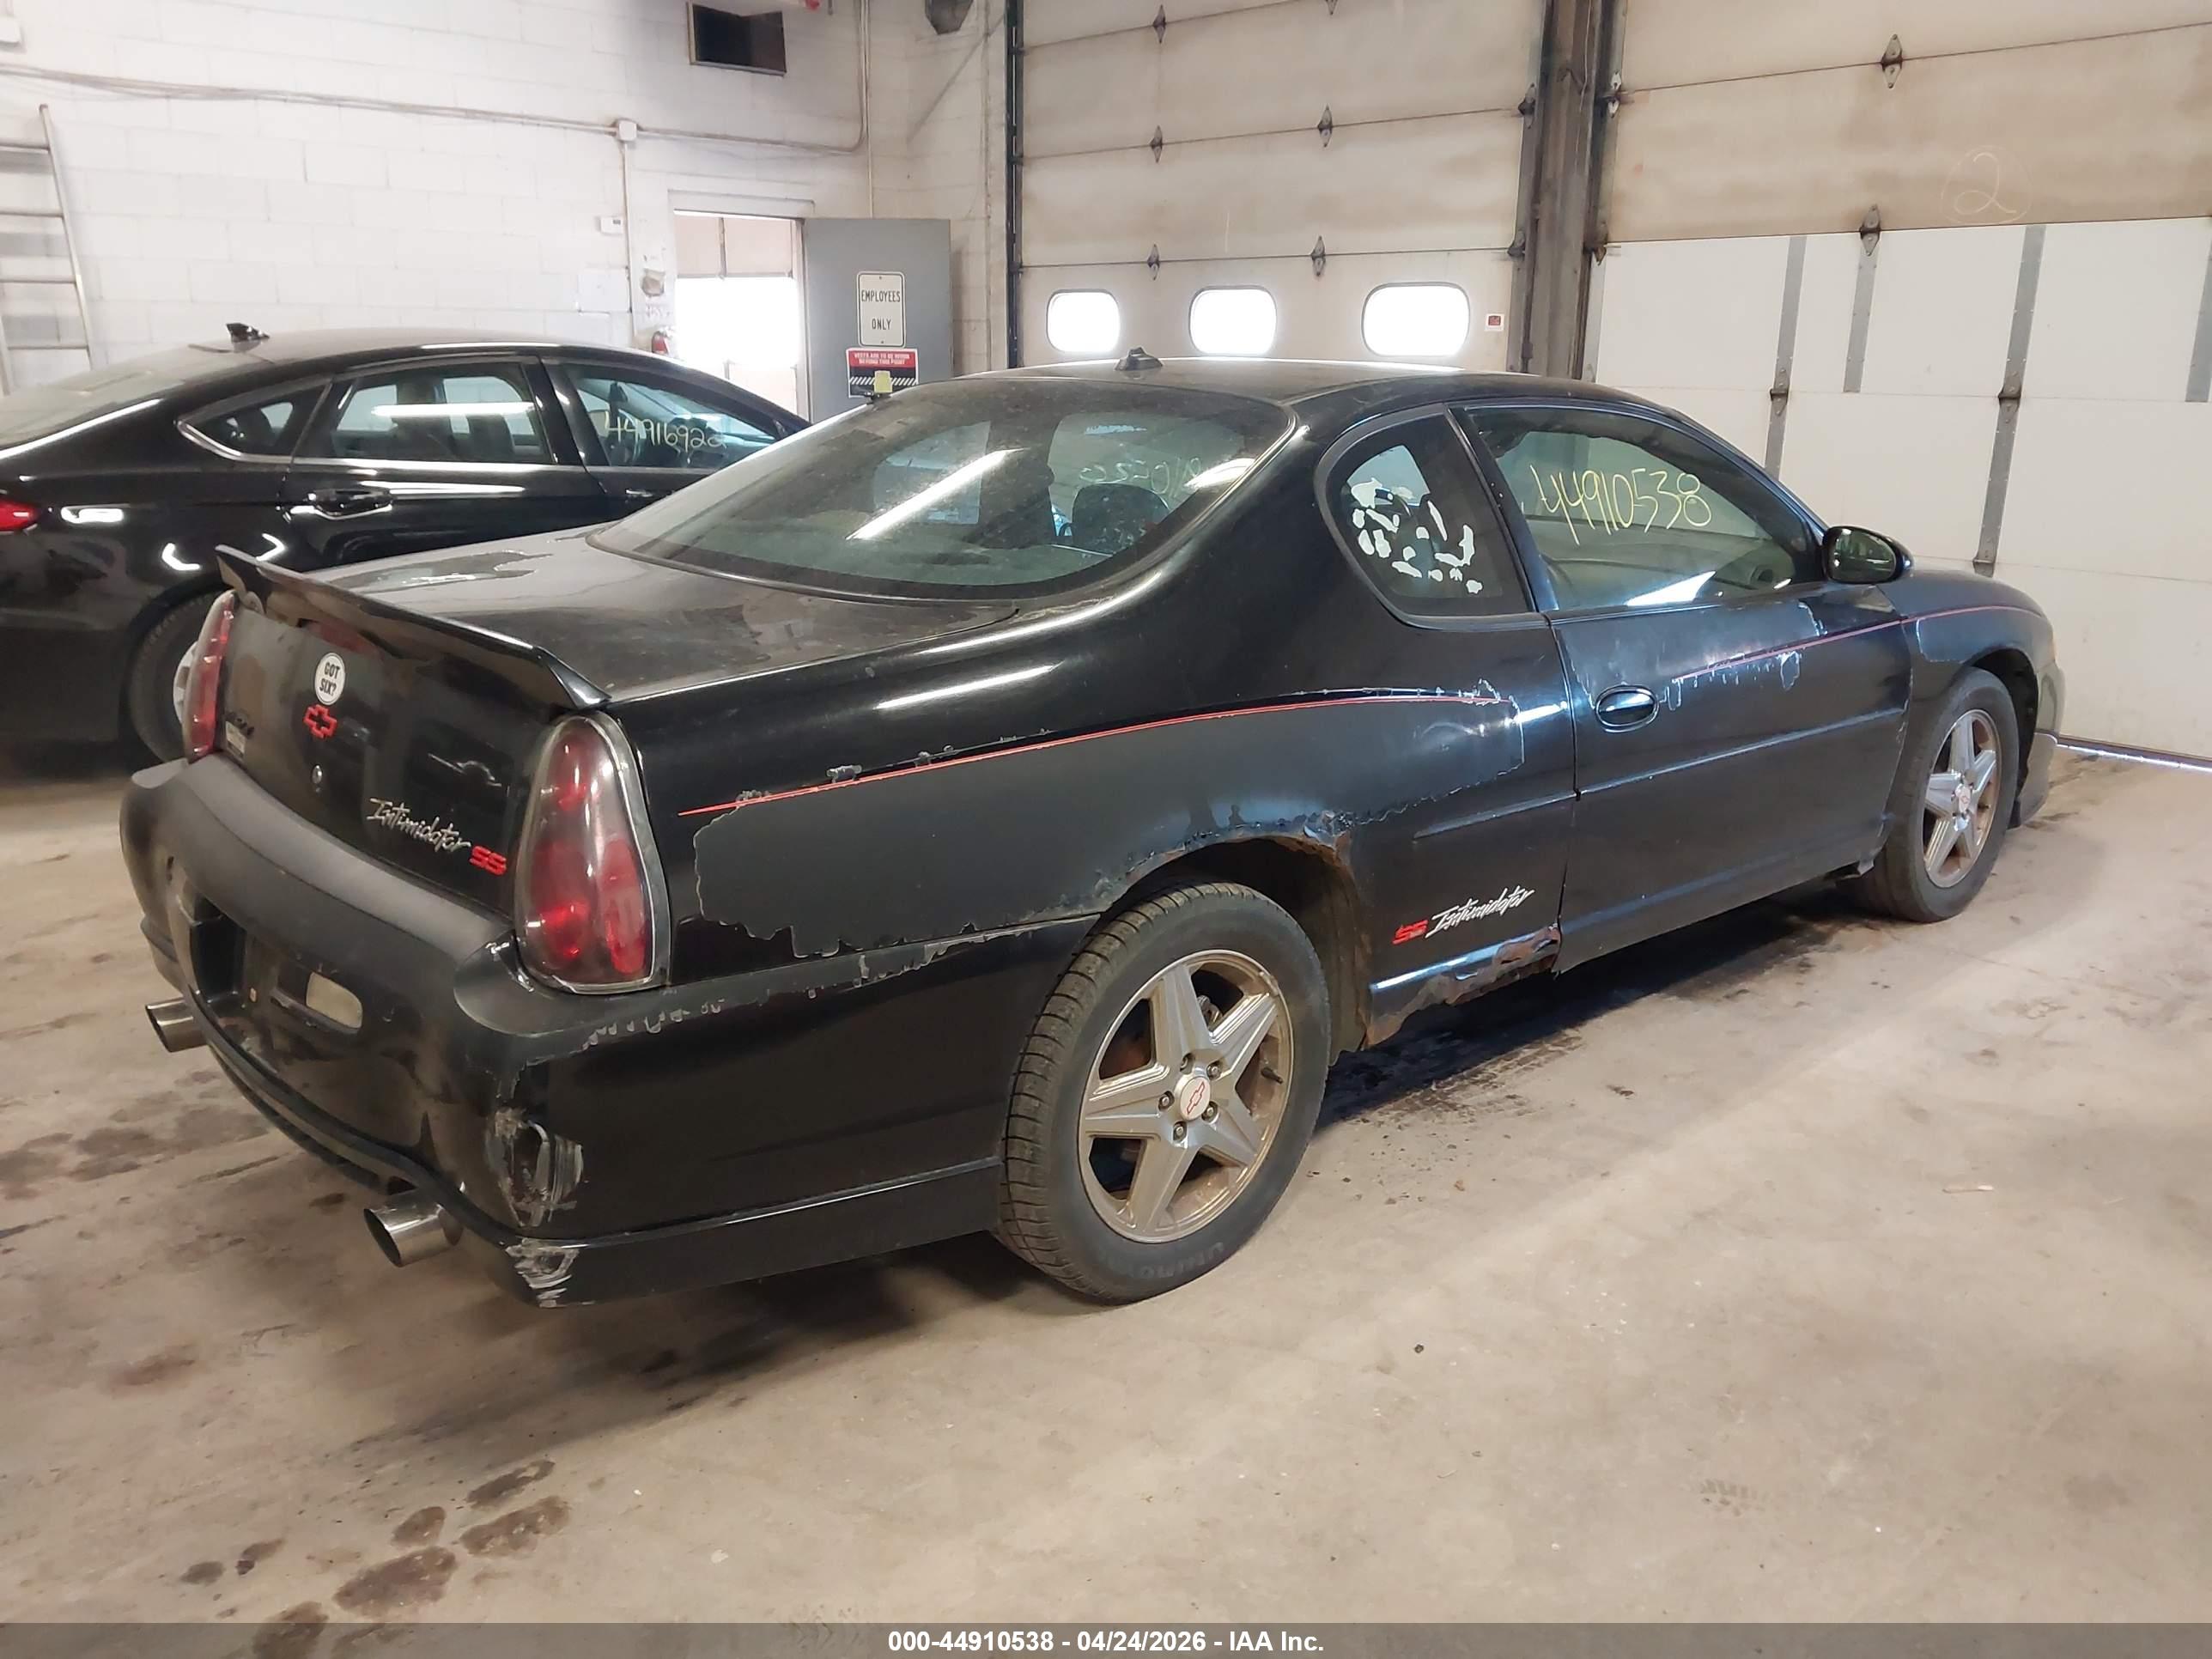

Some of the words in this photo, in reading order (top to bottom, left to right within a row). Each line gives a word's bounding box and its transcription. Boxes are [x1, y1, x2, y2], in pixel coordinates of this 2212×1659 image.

[1954, 152, 2016, 215] 2
[861, 289, 901, 302] EMPLOYEES
[872, 318, 891, 331] ONLY
[1530, 465, 1712, 546] 44910538
[325, 661, 340, 679] GOT
[367, 798, 471, 853] Intimidator
[469, 846, 507, 876] SS
[1392, 920, 1429, 945] SS
[1425, 885, 1535, 939] Intimidator
